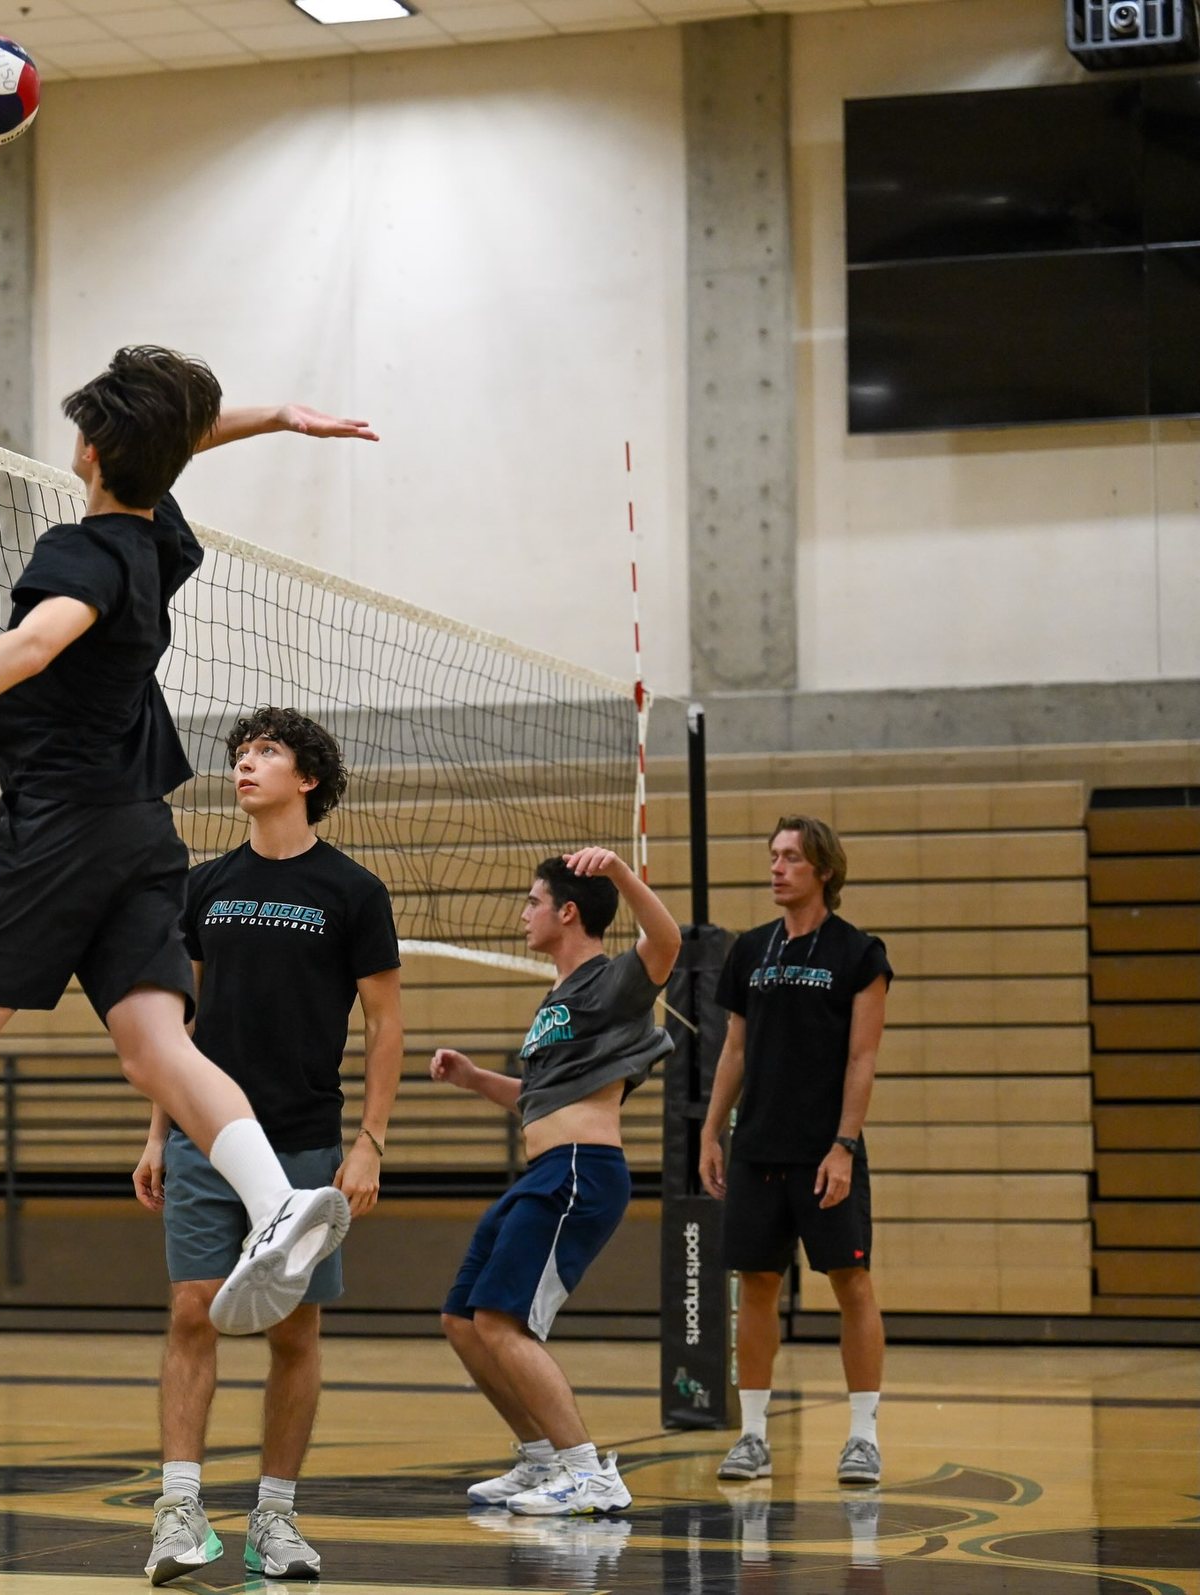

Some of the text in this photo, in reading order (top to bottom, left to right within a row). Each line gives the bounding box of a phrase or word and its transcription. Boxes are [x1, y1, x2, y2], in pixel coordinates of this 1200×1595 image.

[205, 917, 325, 935] BOYS VOLLEYBALL
[207, 901, 326, 926] ALISO NIGUEL
[683, 1222, 701, 1345] sports imports
